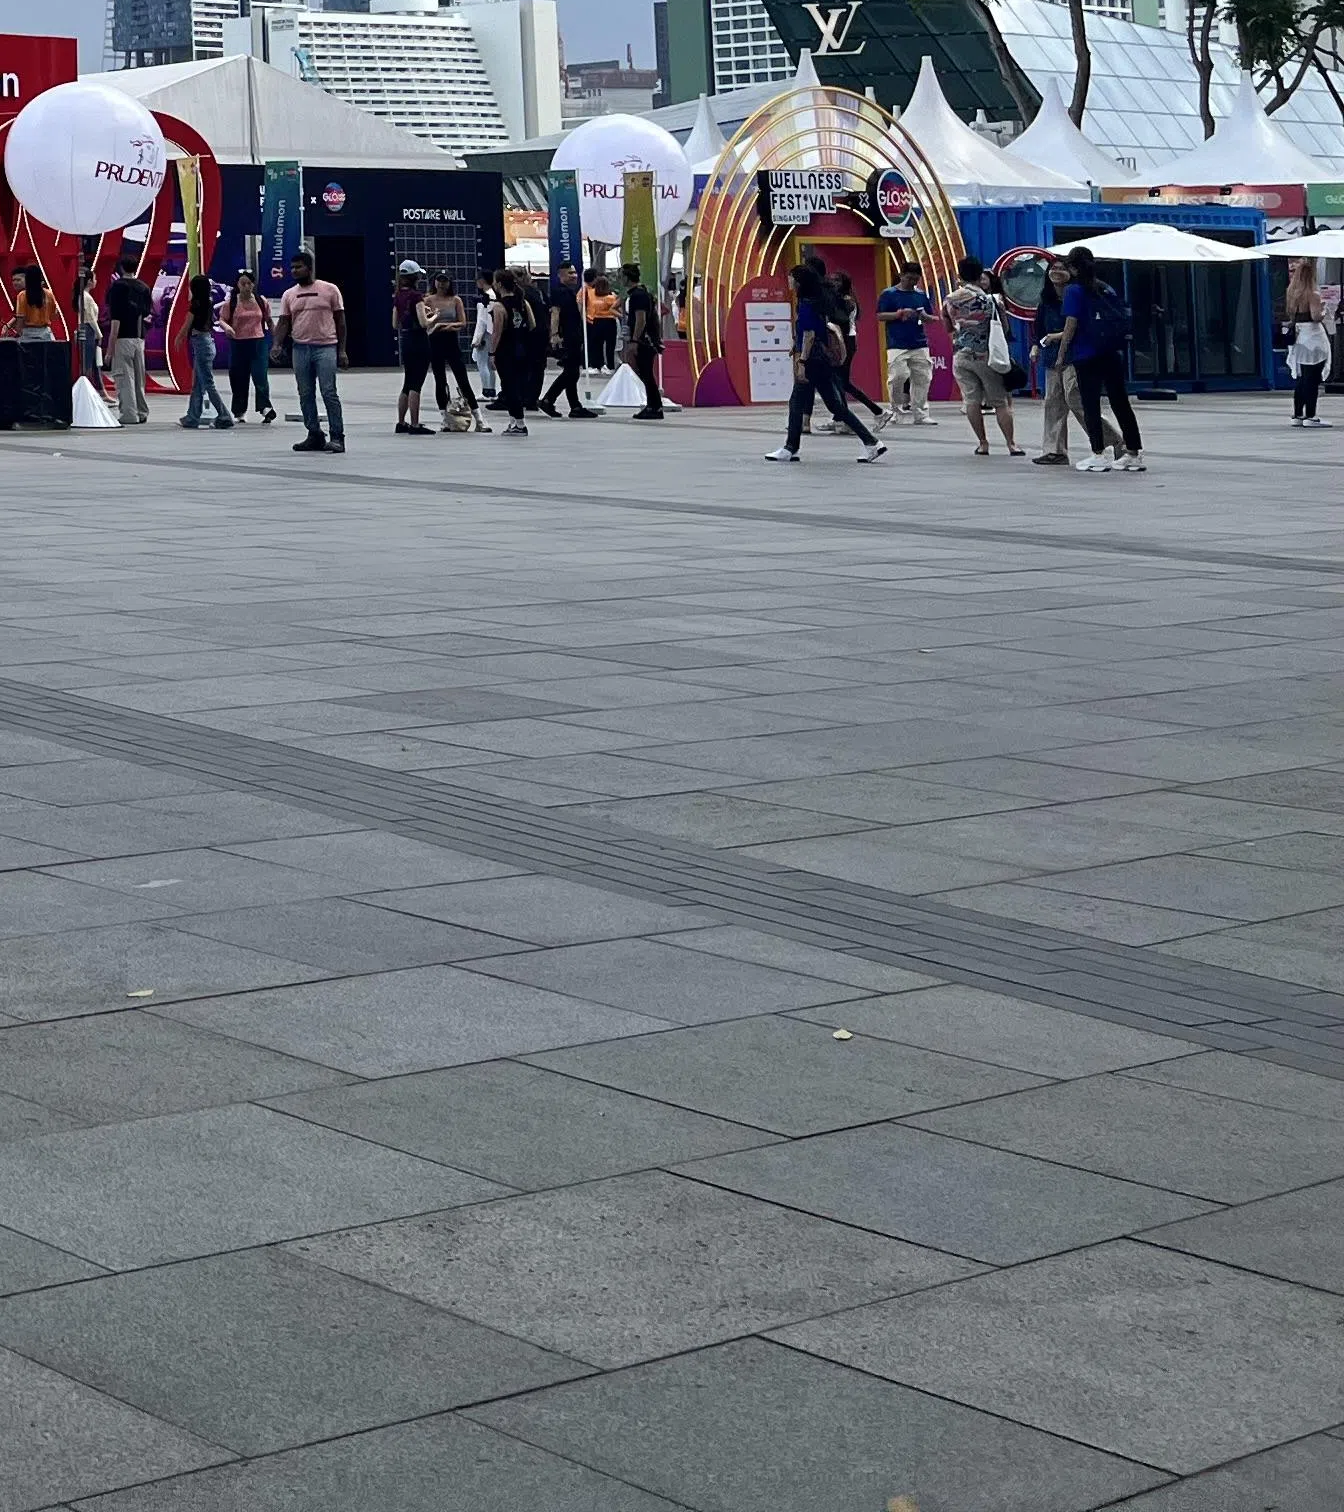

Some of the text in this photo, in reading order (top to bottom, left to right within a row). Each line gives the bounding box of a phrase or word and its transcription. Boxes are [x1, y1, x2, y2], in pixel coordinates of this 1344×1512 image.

[770, 171, 842, 190] WELLNESS
[772, 193, 835, 211] FESTIVAL
[272, 199, 286, 261] lululemon
[559, 206, 570, 261] ululemon
